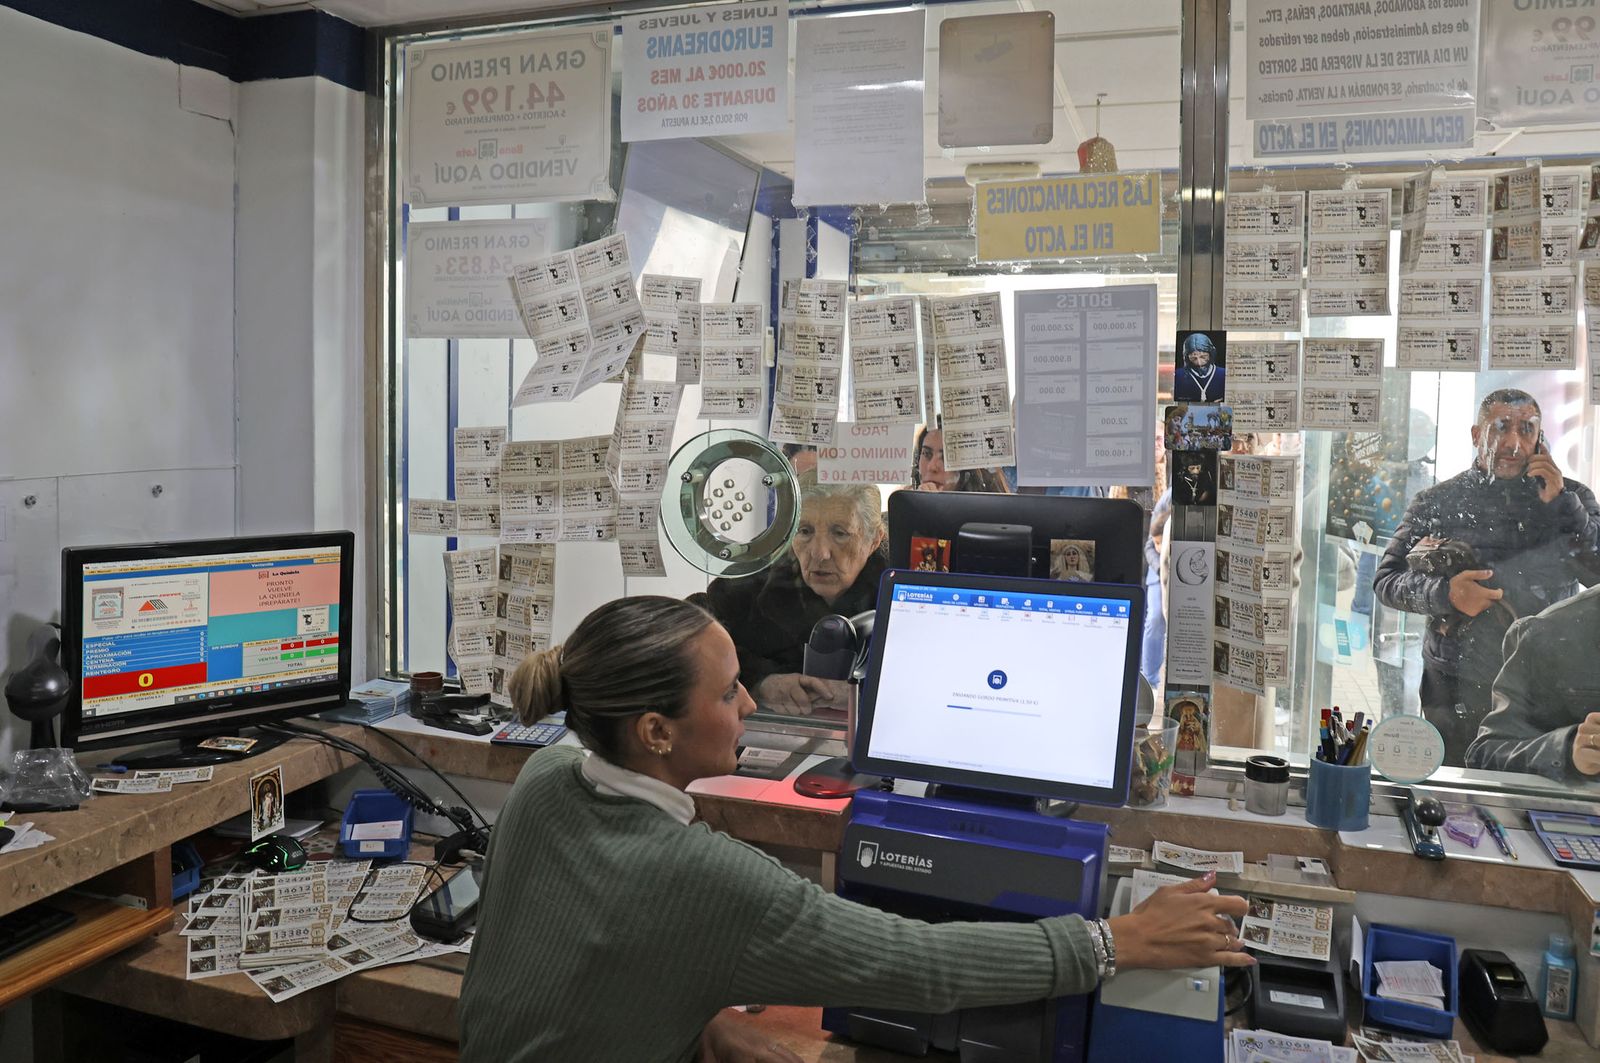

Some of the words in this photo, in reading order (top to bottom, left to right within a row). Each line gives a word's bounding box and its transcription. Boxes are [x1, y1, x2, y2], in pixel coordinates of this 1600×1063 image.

[266, 579, 294, 587] PRONTO
[268, 591, 301, 599] QUINIELA
[86, 641, 116, 649] ESPECIAL
[138, 673, 154, 688] 0
[880, 851, 933, 868] LOTERÍAS
[884, 862, 905, 870] APUESTAS
